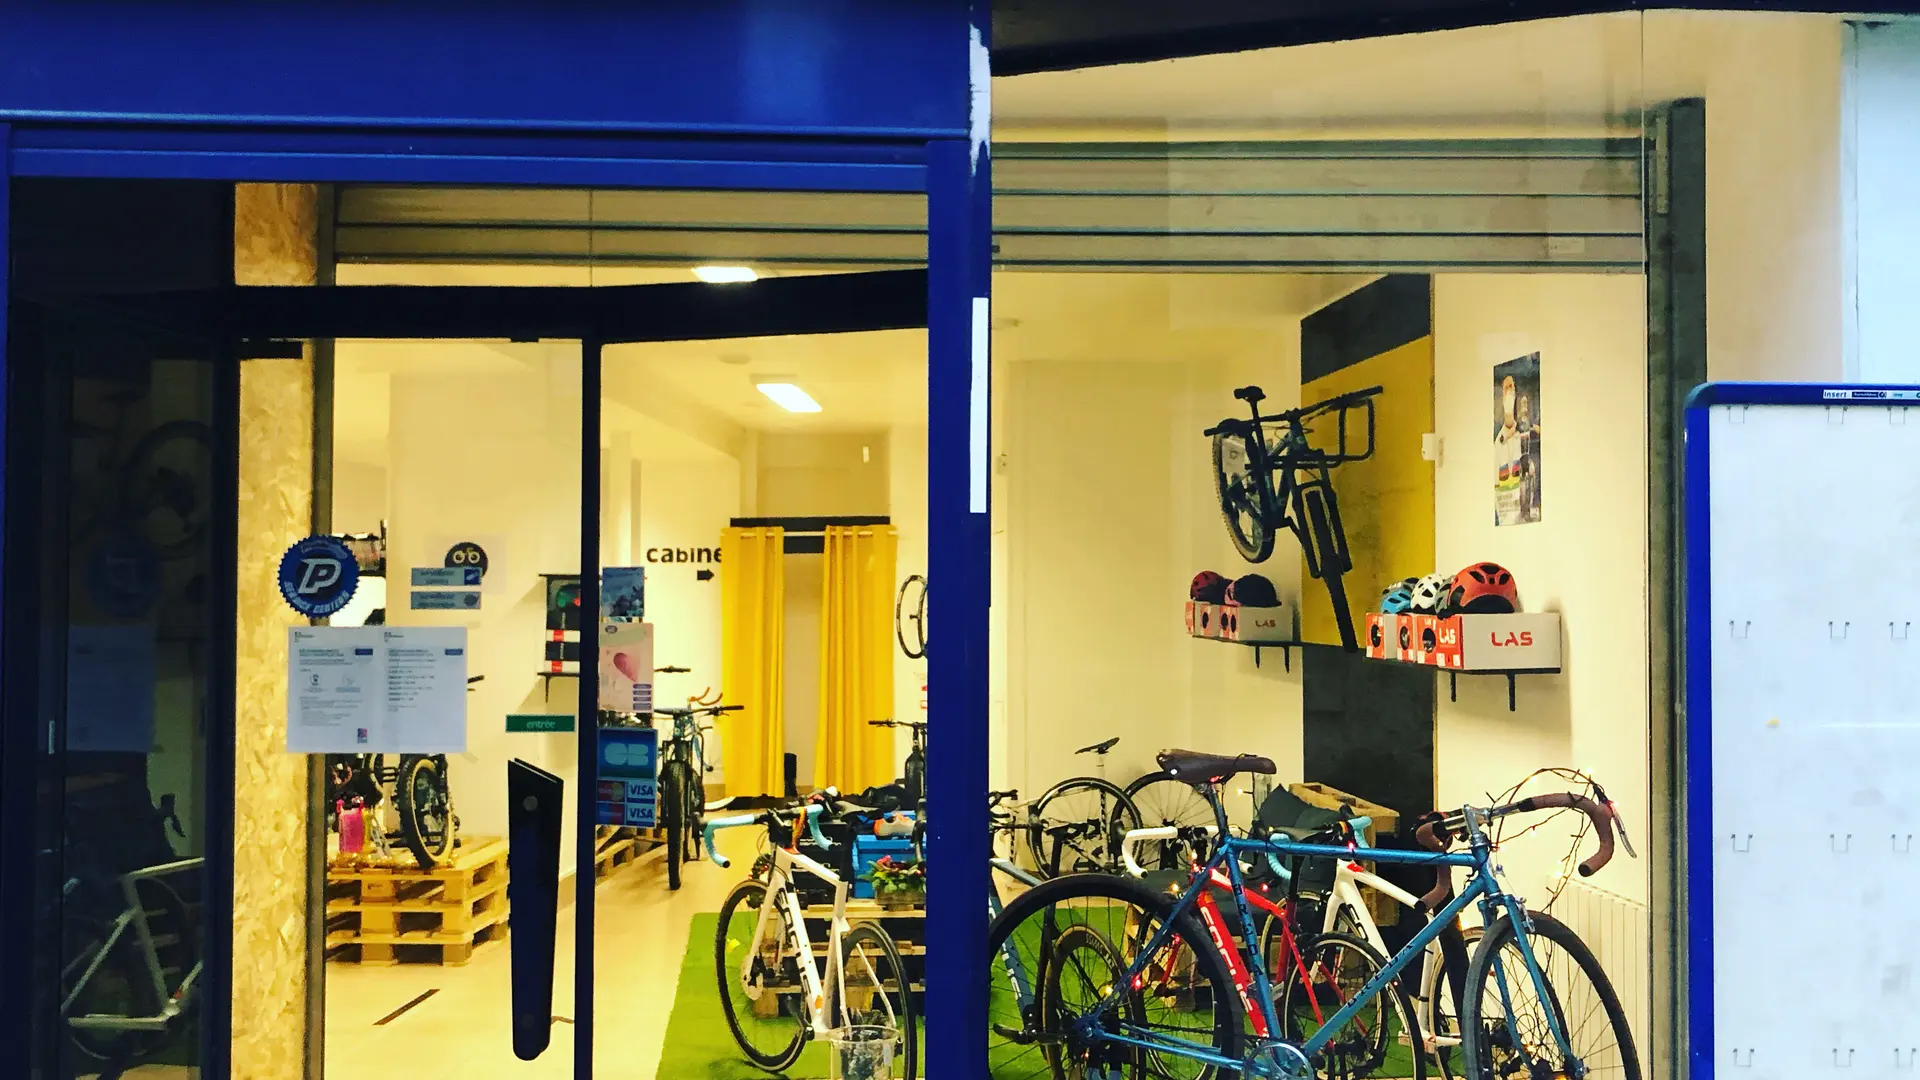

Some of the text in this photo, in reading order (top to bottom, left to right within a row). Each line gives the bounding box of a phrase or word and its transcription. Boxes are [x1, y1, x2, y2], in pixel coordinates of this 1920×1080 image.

[1255, 620, 1277, 628] LAS
[1439, 628, 1456, 645] LAS
[1490, 631, 1533, 647] LAS
[526, 719, 556, 729] entrée
[604, 742, 649, 766] CB
[629, 784, 654, 796] VISA
[629, 808, 654, 820] VISA
